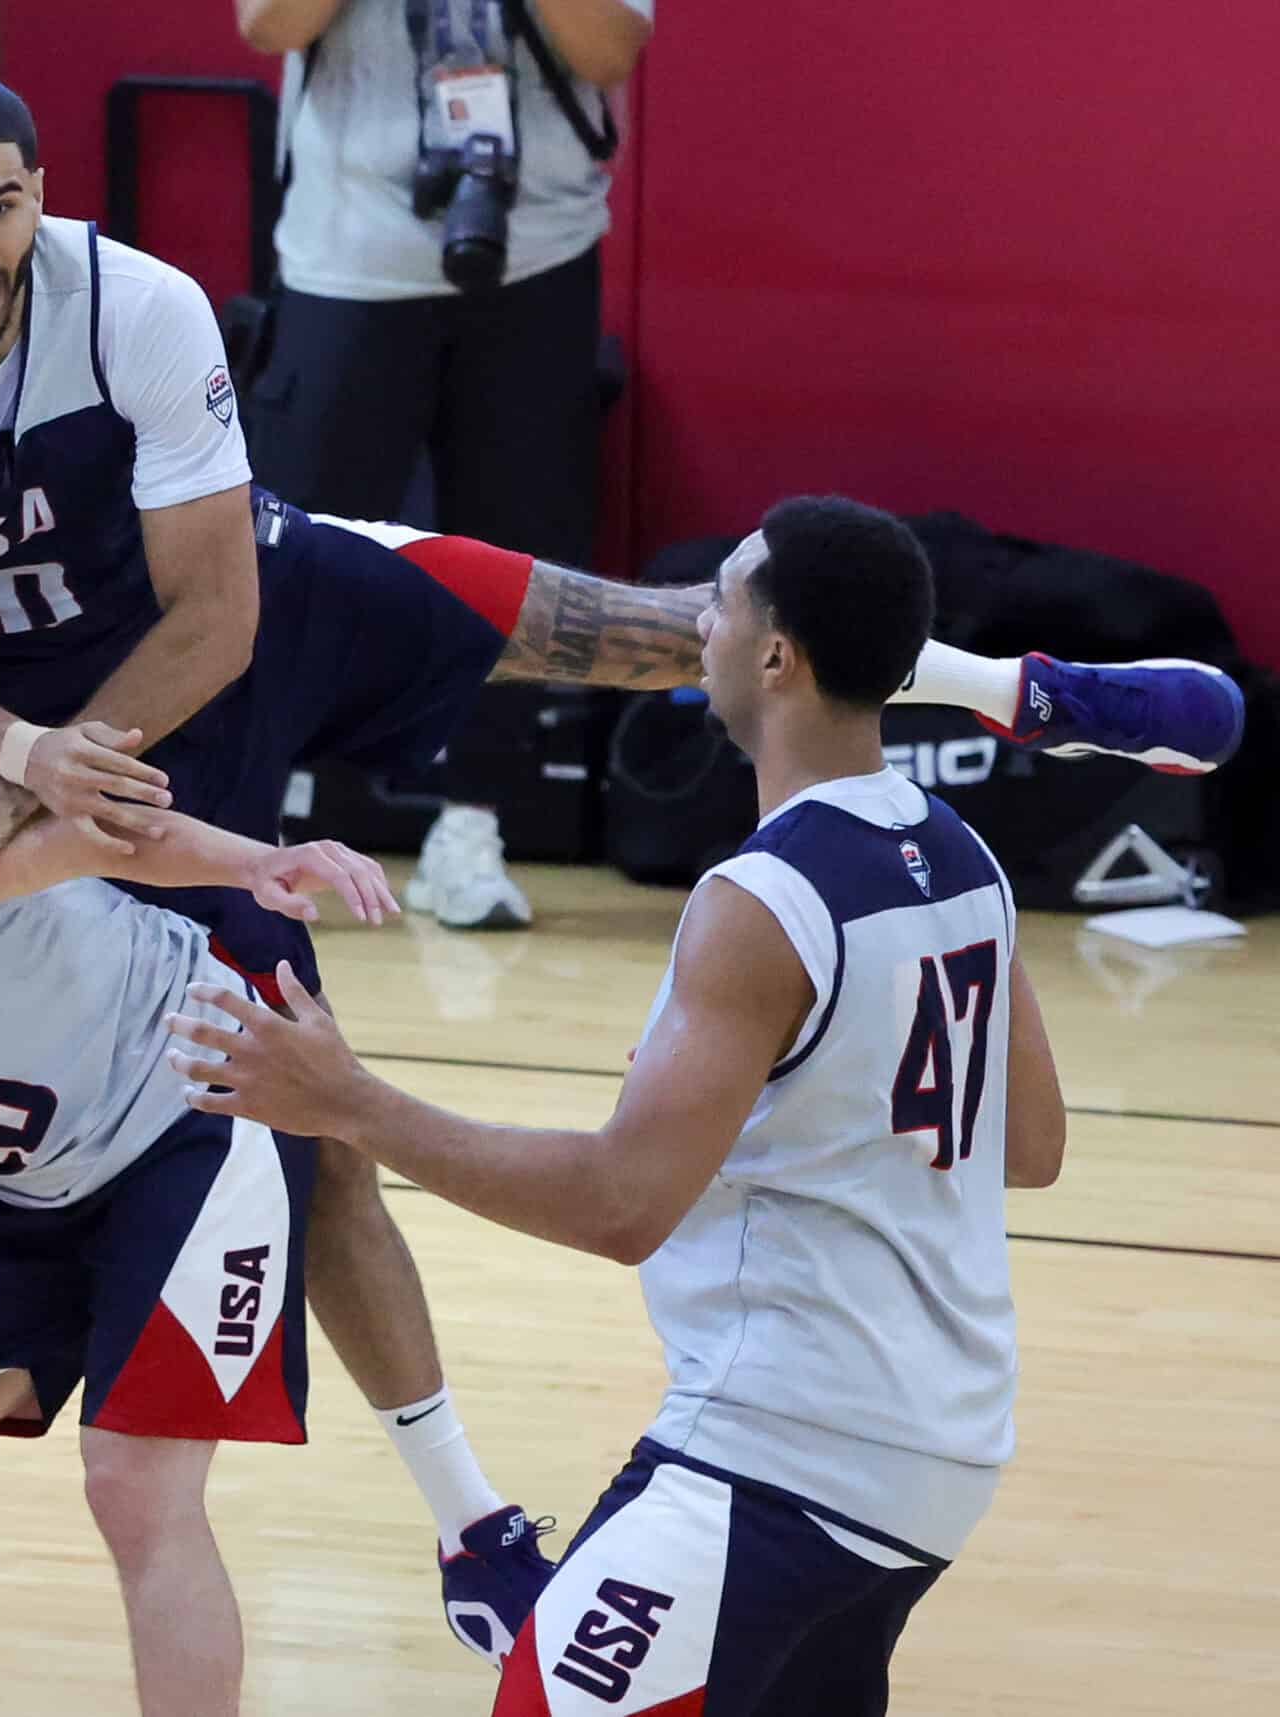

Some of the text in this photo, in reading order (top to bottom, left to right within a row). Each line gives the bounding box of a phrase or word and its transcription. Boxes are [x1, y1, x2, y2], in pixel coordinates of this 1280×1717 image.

[891, 938, 998, 1171] 47
[213, 1244, 270, 1358] USA
[552, 1578, 675, 1704] USA
